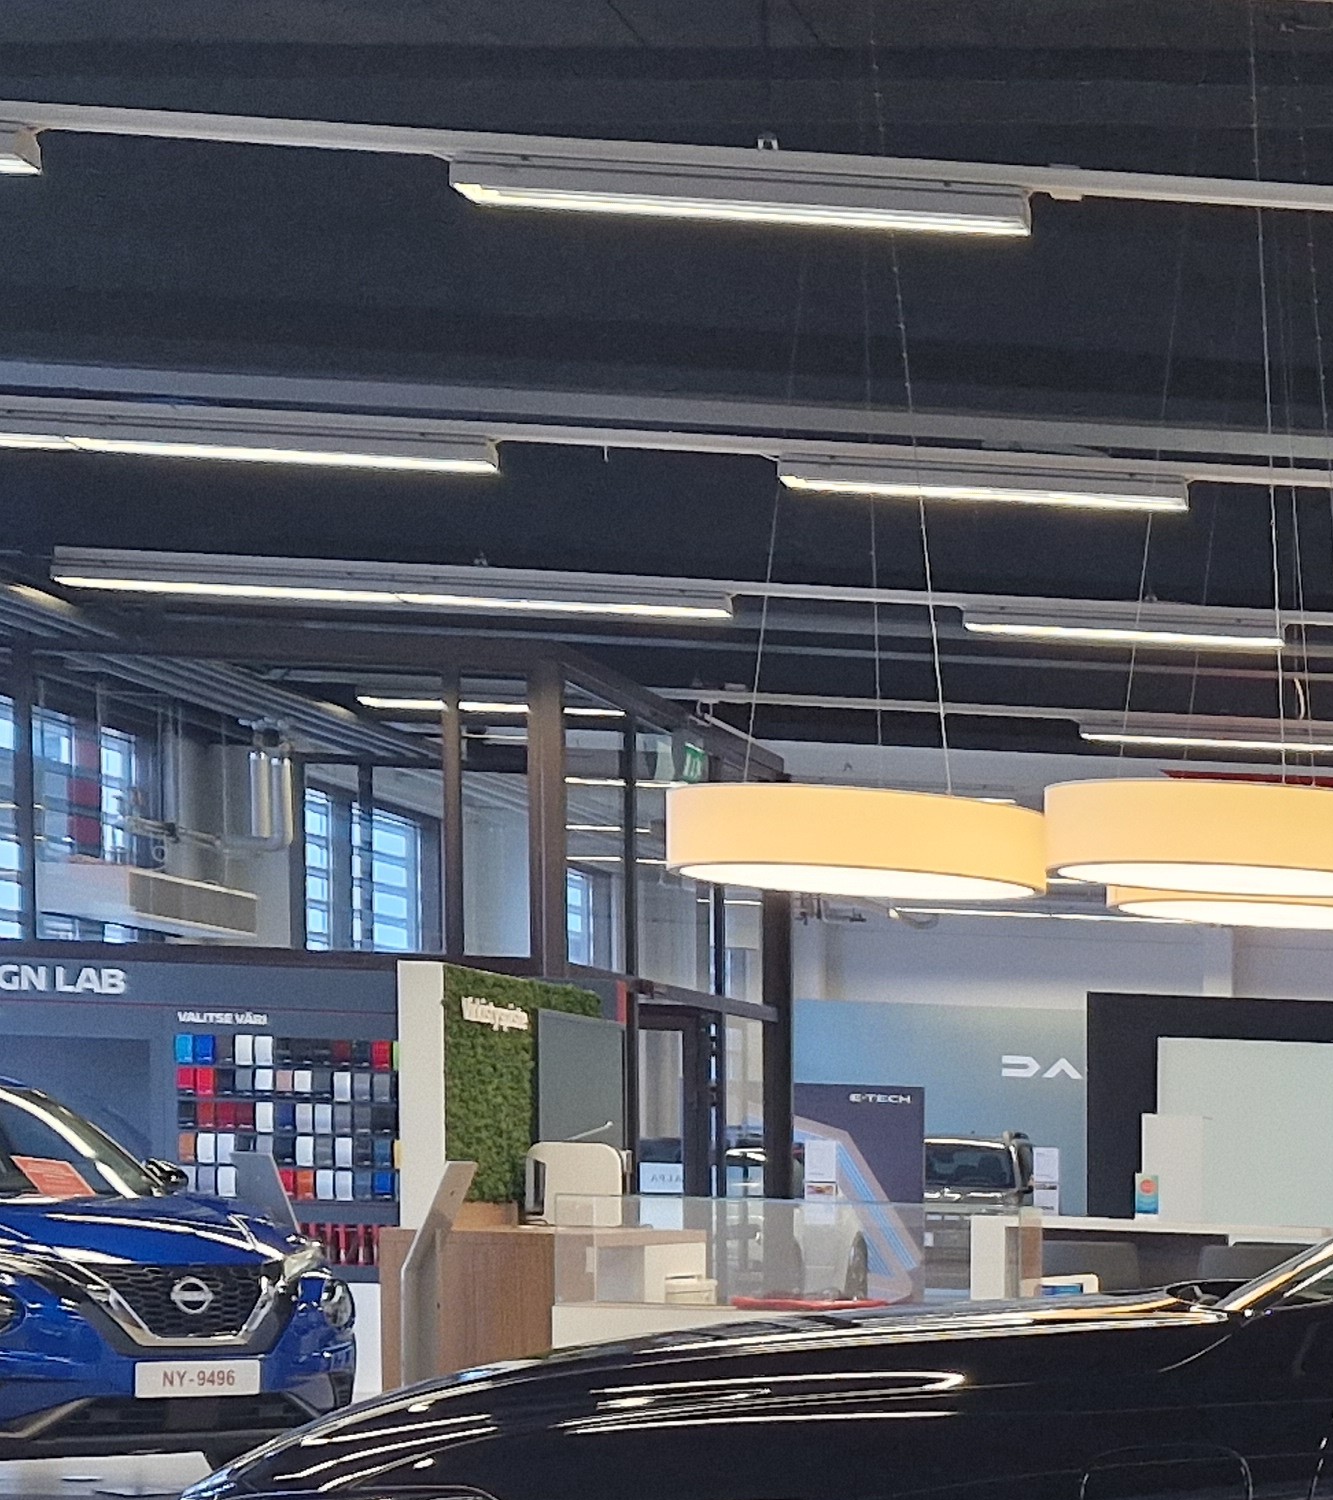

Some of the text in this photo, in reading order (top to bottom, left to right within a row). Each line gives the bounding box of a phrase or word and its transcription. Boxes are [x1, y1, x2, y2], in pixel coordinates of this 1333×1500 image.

[0, 964, 127, 995] GN LAB
[177, 1010, 268, 1026] VALITSE VÄRI
[162, 1369, 236, 1388] NY-9496
